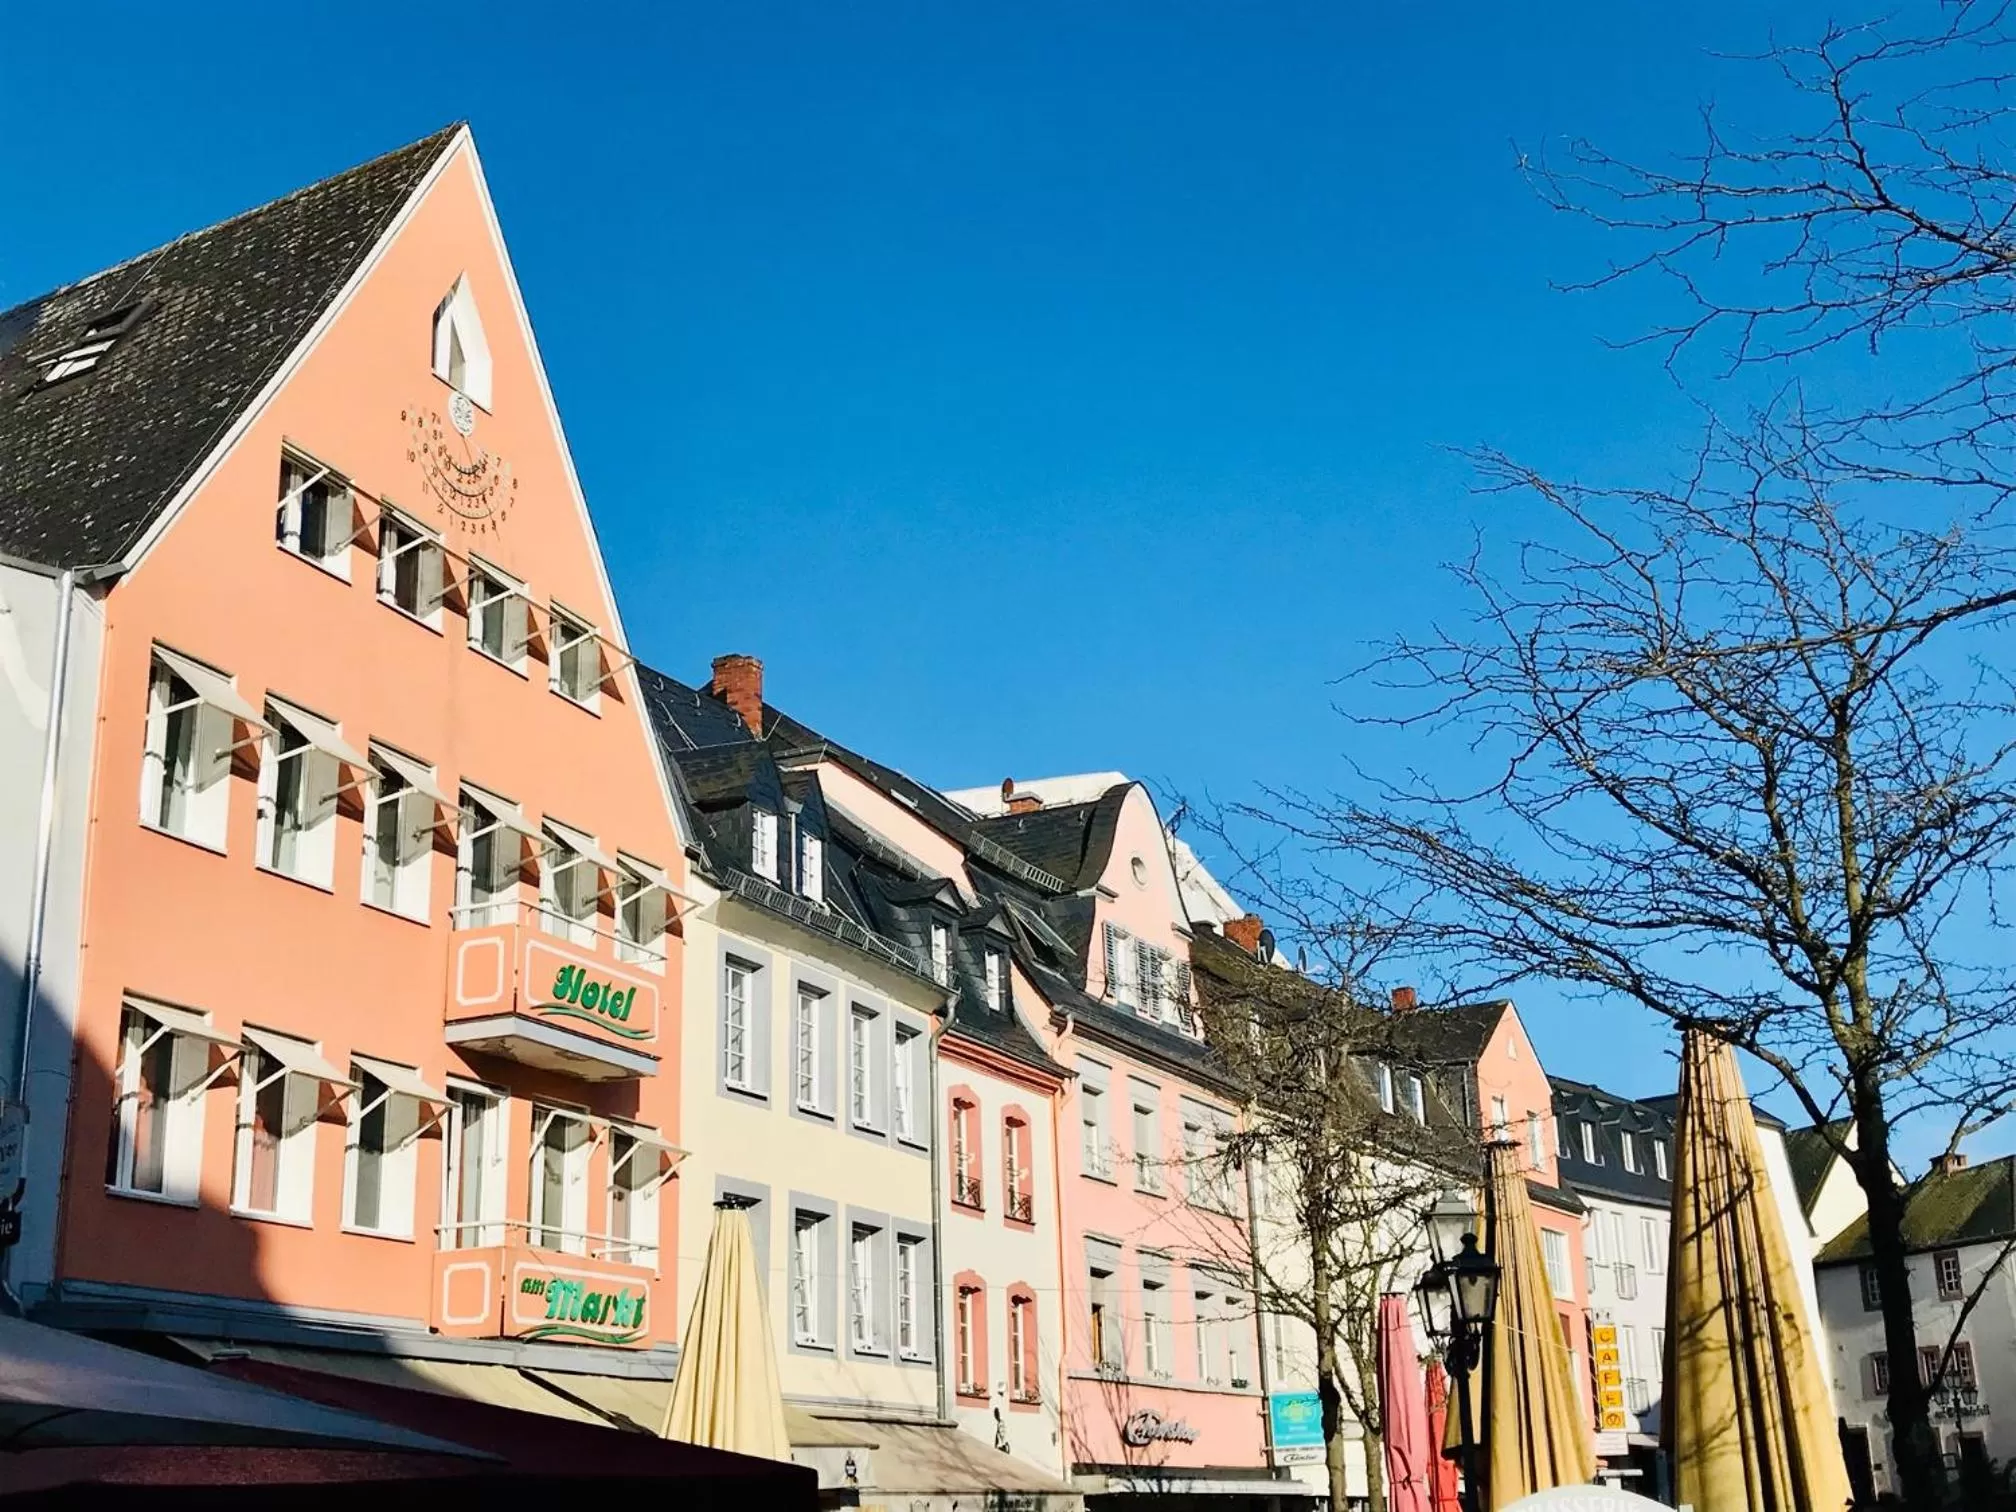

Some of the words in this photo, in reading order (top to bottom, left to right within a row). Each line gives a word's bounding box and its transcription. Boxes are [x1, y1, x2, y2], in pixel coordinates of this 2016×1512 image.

[551, 964, 638, 1022] Hotel
[520, 1276, 546, 1295] am
[545, 1276, 646, 1329] Markt
